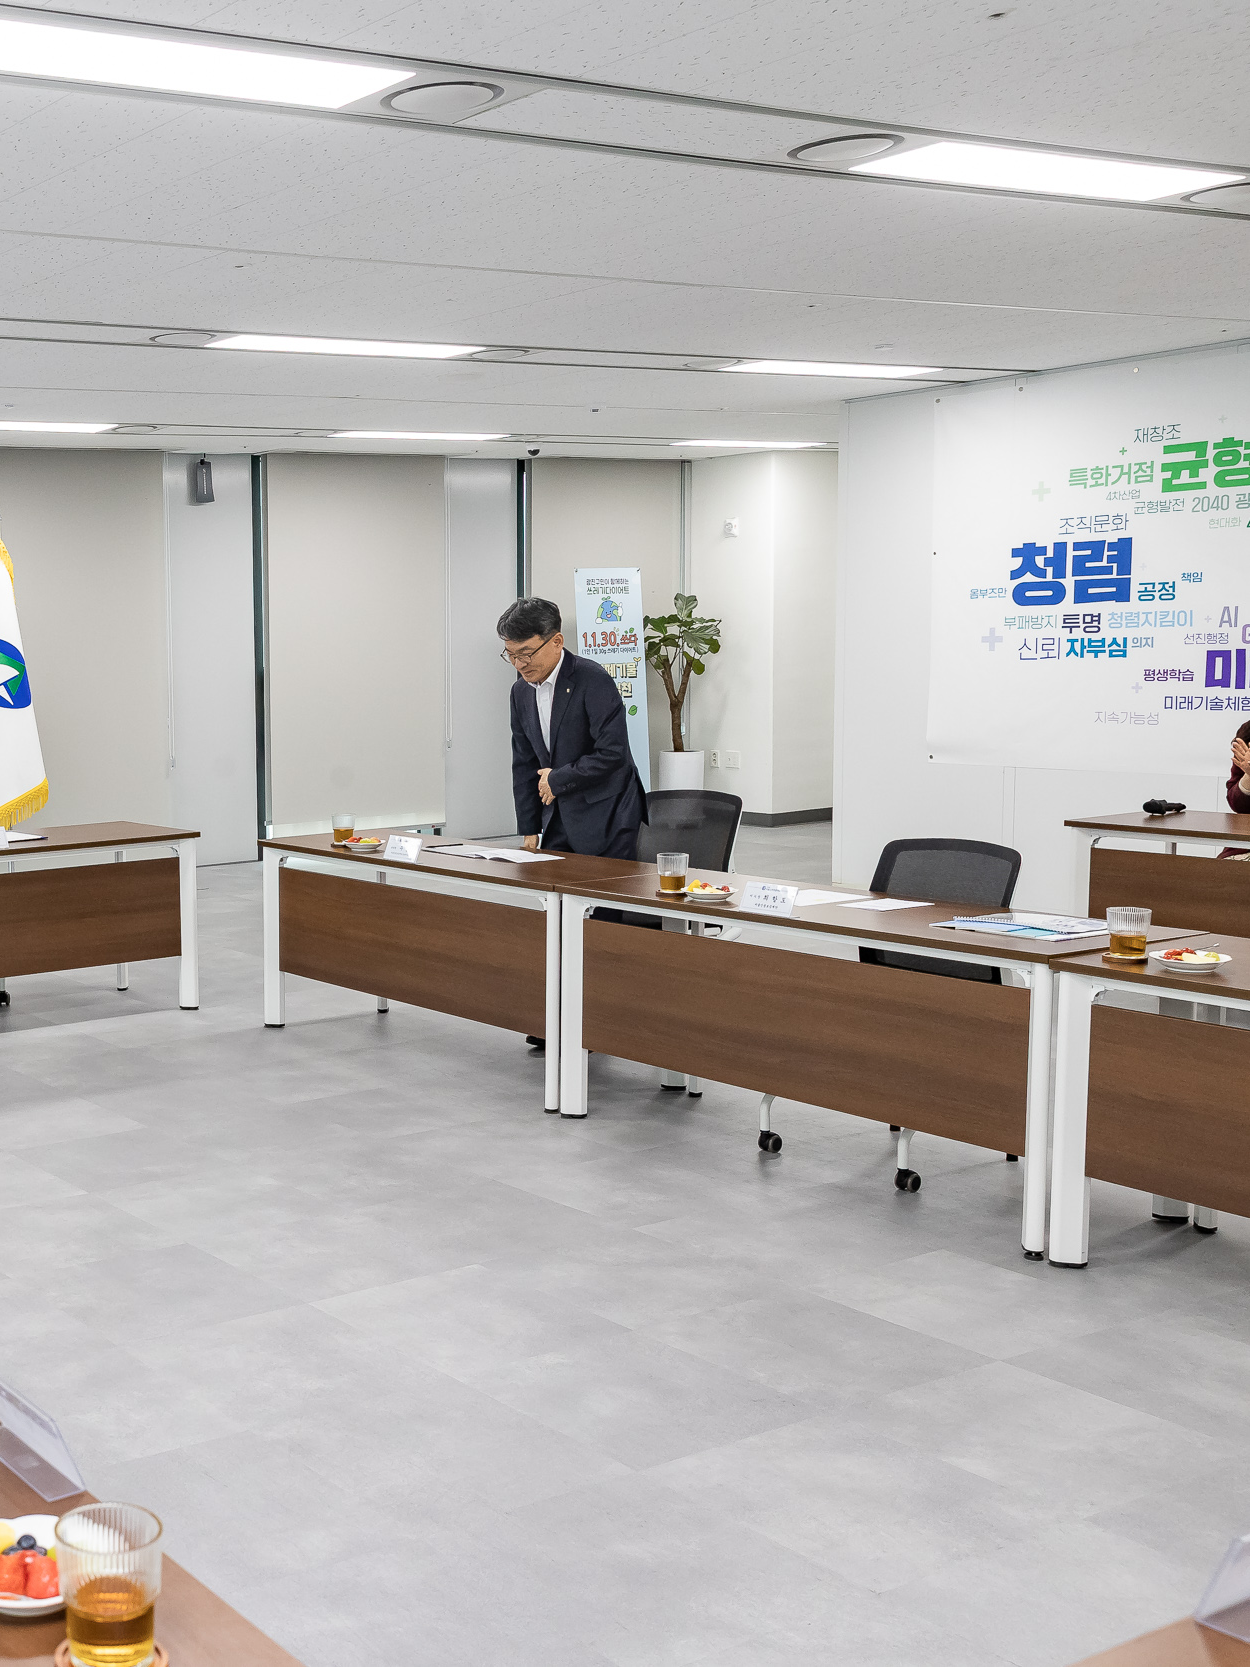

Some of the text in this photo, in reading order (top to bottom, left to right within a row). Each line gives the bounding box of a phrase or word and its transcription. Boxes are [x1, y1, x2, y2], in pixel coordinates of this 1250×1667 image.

[1133, 423, 1181, 443] 재창조
[1068, 460, 1155, 489] 특화거점
[1106, 489, 1141, 501] 4차산업
[1191, 494, 1230, 513] 2040
[1133, 498, 1185, 515] 균형발전
[1058, 512, 1129, 535] 조직문화
[1208, 516, 1242, 529] 현대화
[1010, 537, 1133, 606] 청렴
[1181, 571, 1203, 583] 책임
[586, 586, 630, 596] 쓰레기다이어트
[969, 587, 1008, 600] 옴부즈만
[1137, 581, 1176, 602] 공정
[1003, 614, 1058, 630] 부패방지
[1061, 612, 1102, 634] 투명
[1107, 609, 1194, 629] 청렴지킴이
[1218, 605, 1239, 628] AI
[1065, 636, 1128, 659] 자부심
[1131, 636, 1154, 649] 의지
[1183, 632, 1229, 645] 선진행정
[1018, 637, 1061, 661] 신뢰
[1143, 668, 1195, 682] 평생학습
[1094, 711, 1160, 726] 지속가능성
